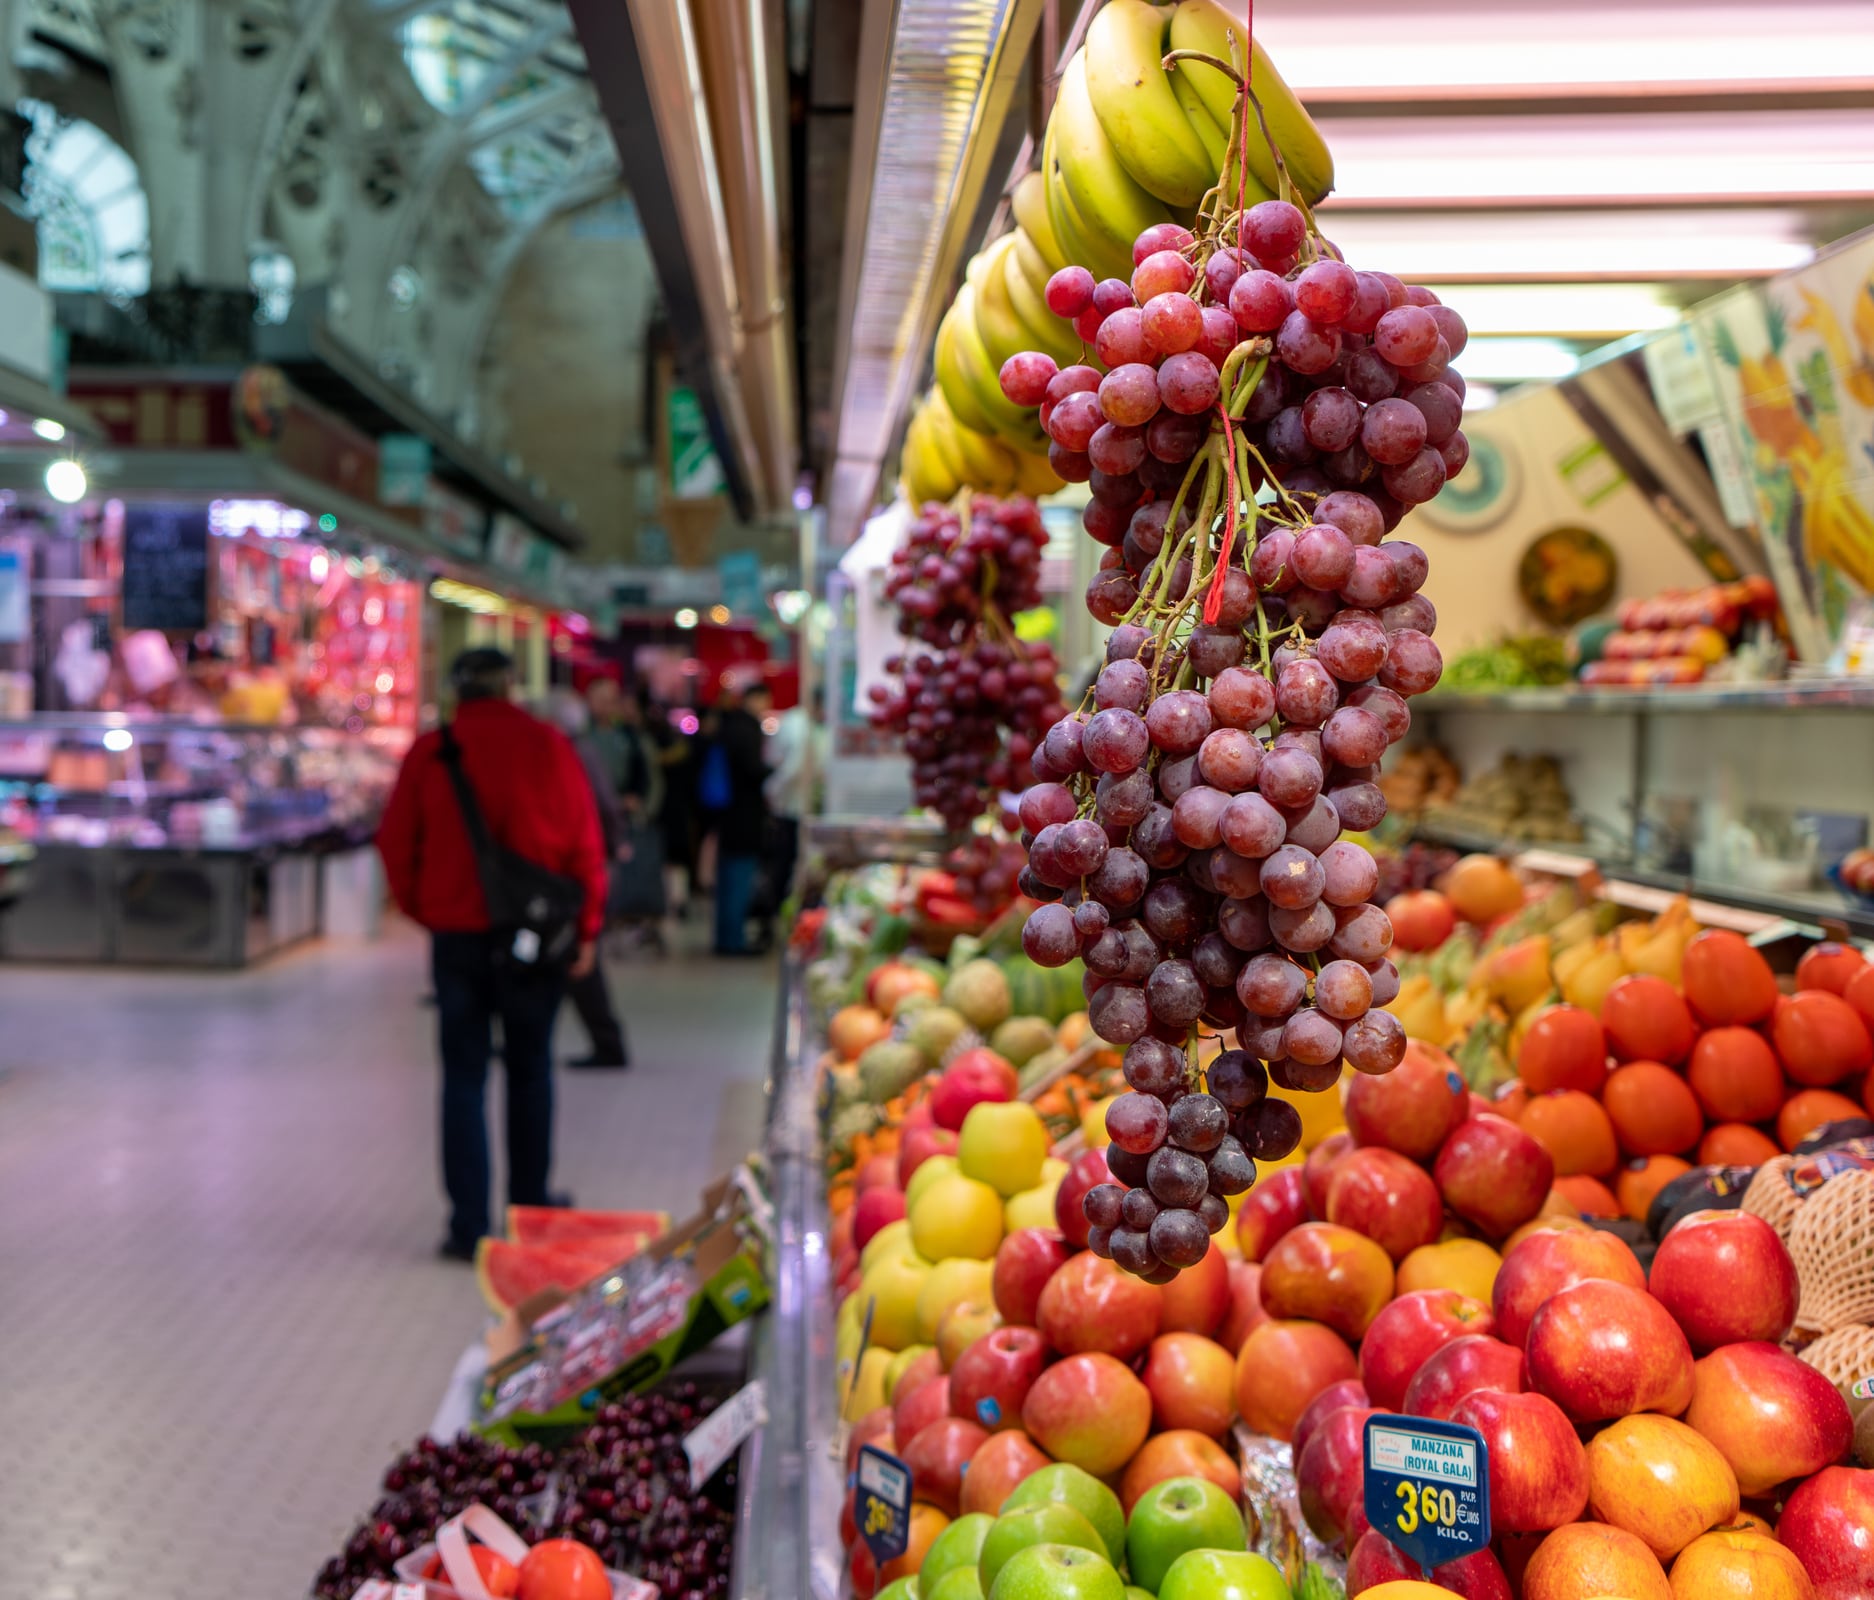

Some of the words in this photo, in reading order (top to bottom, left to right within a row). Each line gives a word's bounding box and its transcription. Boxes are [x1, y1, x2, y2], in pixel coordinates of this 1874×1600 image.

[1411, 1438, 1464, 1458] MANZANA
[1404, 1455, 1439, 1472] (ROYAL
[1442, 1461, 1472, 1480] GALA)
[1460, 1490, 1477, 1503] P.V.P.
[1437, 1526, 1473, 1542] KILO.
